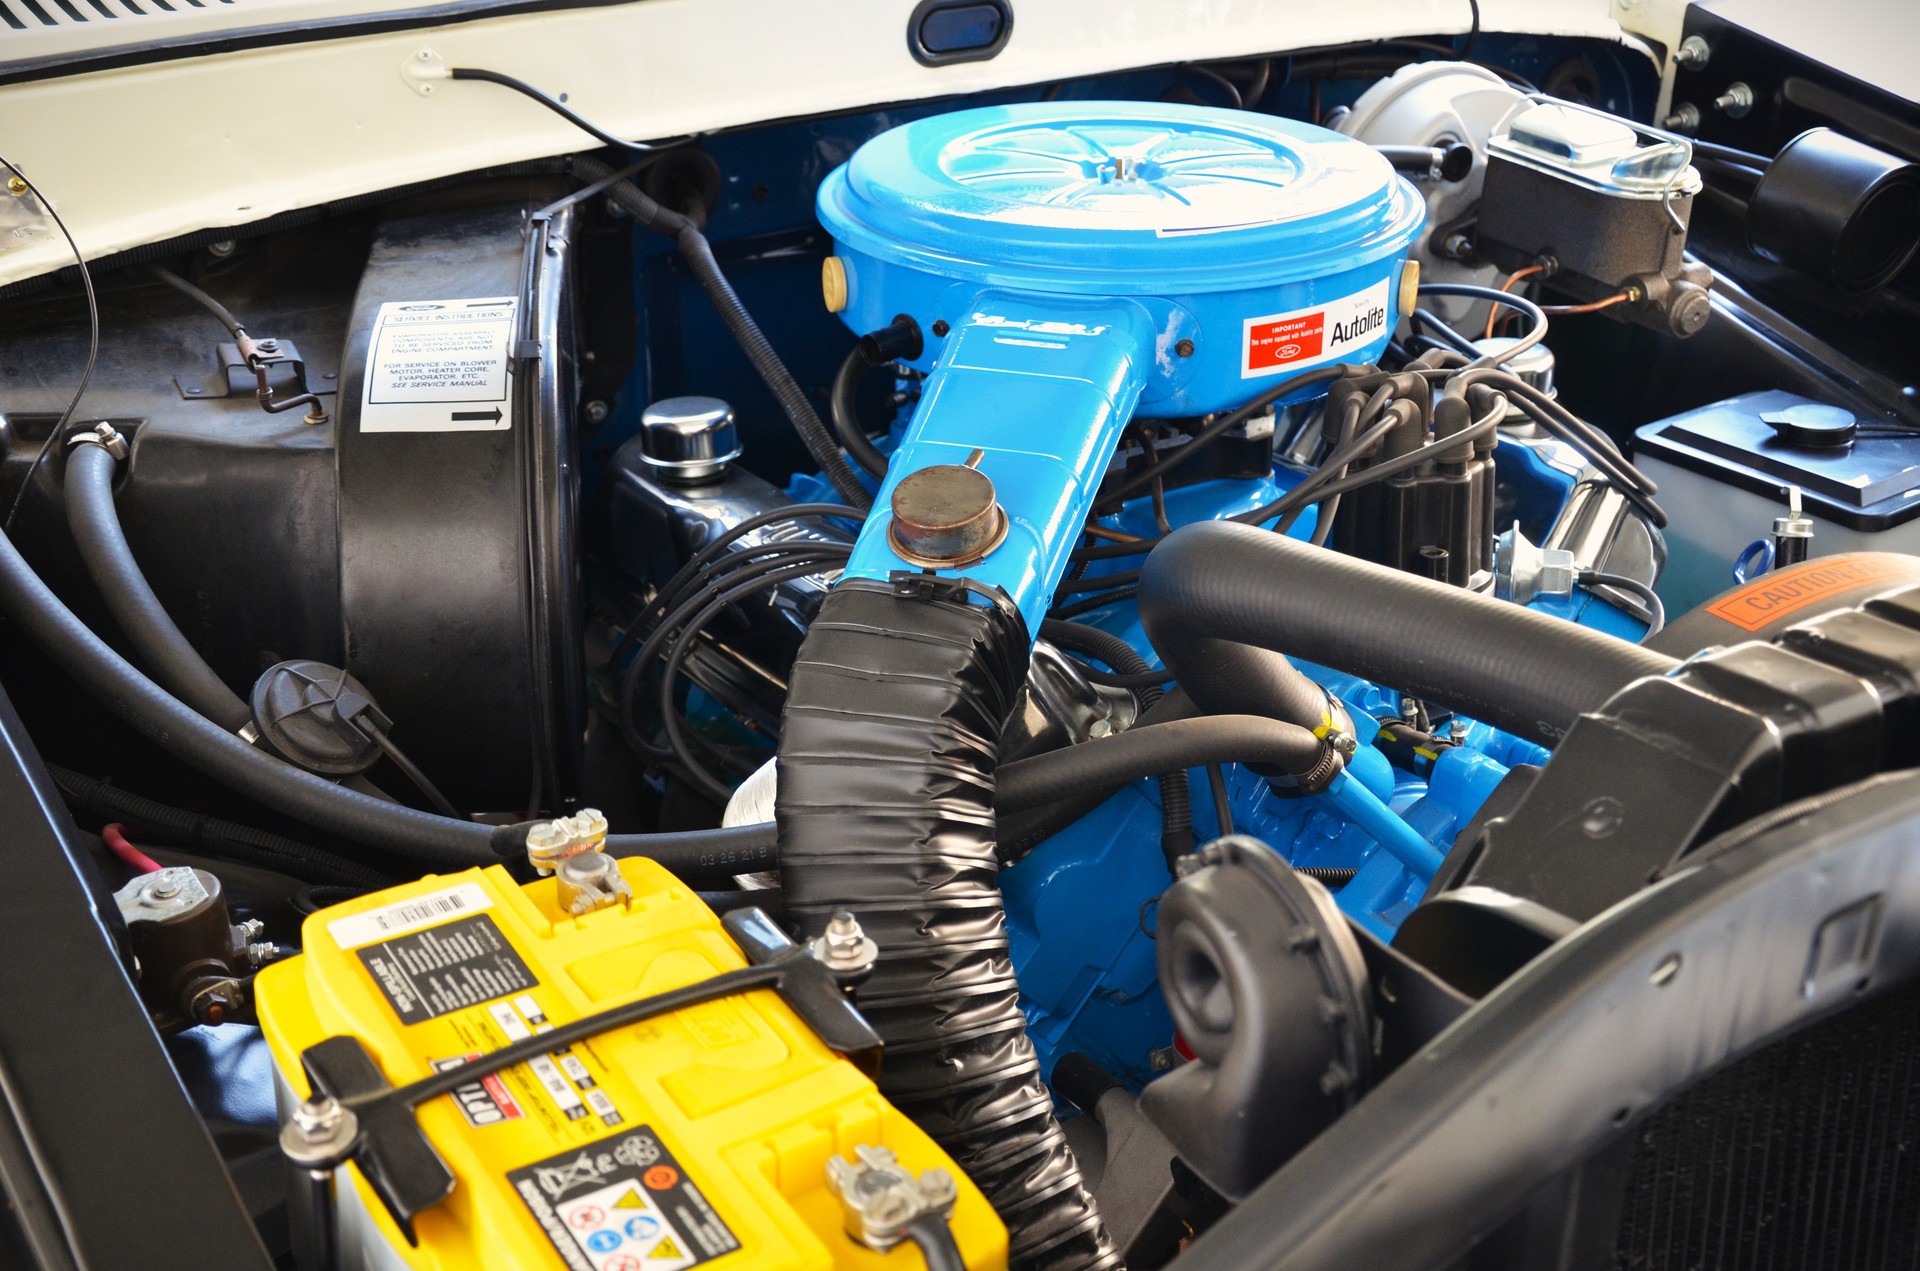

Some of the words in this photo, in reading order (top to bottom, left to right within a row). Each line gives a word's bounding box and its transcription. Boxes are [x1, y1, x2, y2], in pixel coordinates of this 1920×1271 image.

[435, 311, 504, 320] INSTRUCTIONS
[1272, 321, 1306, 334] IMPORTANT
[1330, 306, 1384, 347] Autolite
[393, 336, 453, 344] COMPONENTS
[1251, 338, 1259, 346] This
[1300, 329, 1314, 337] Autolite
[700, 854, 715, 866] 03
[720, 851, 736, 864] 26
